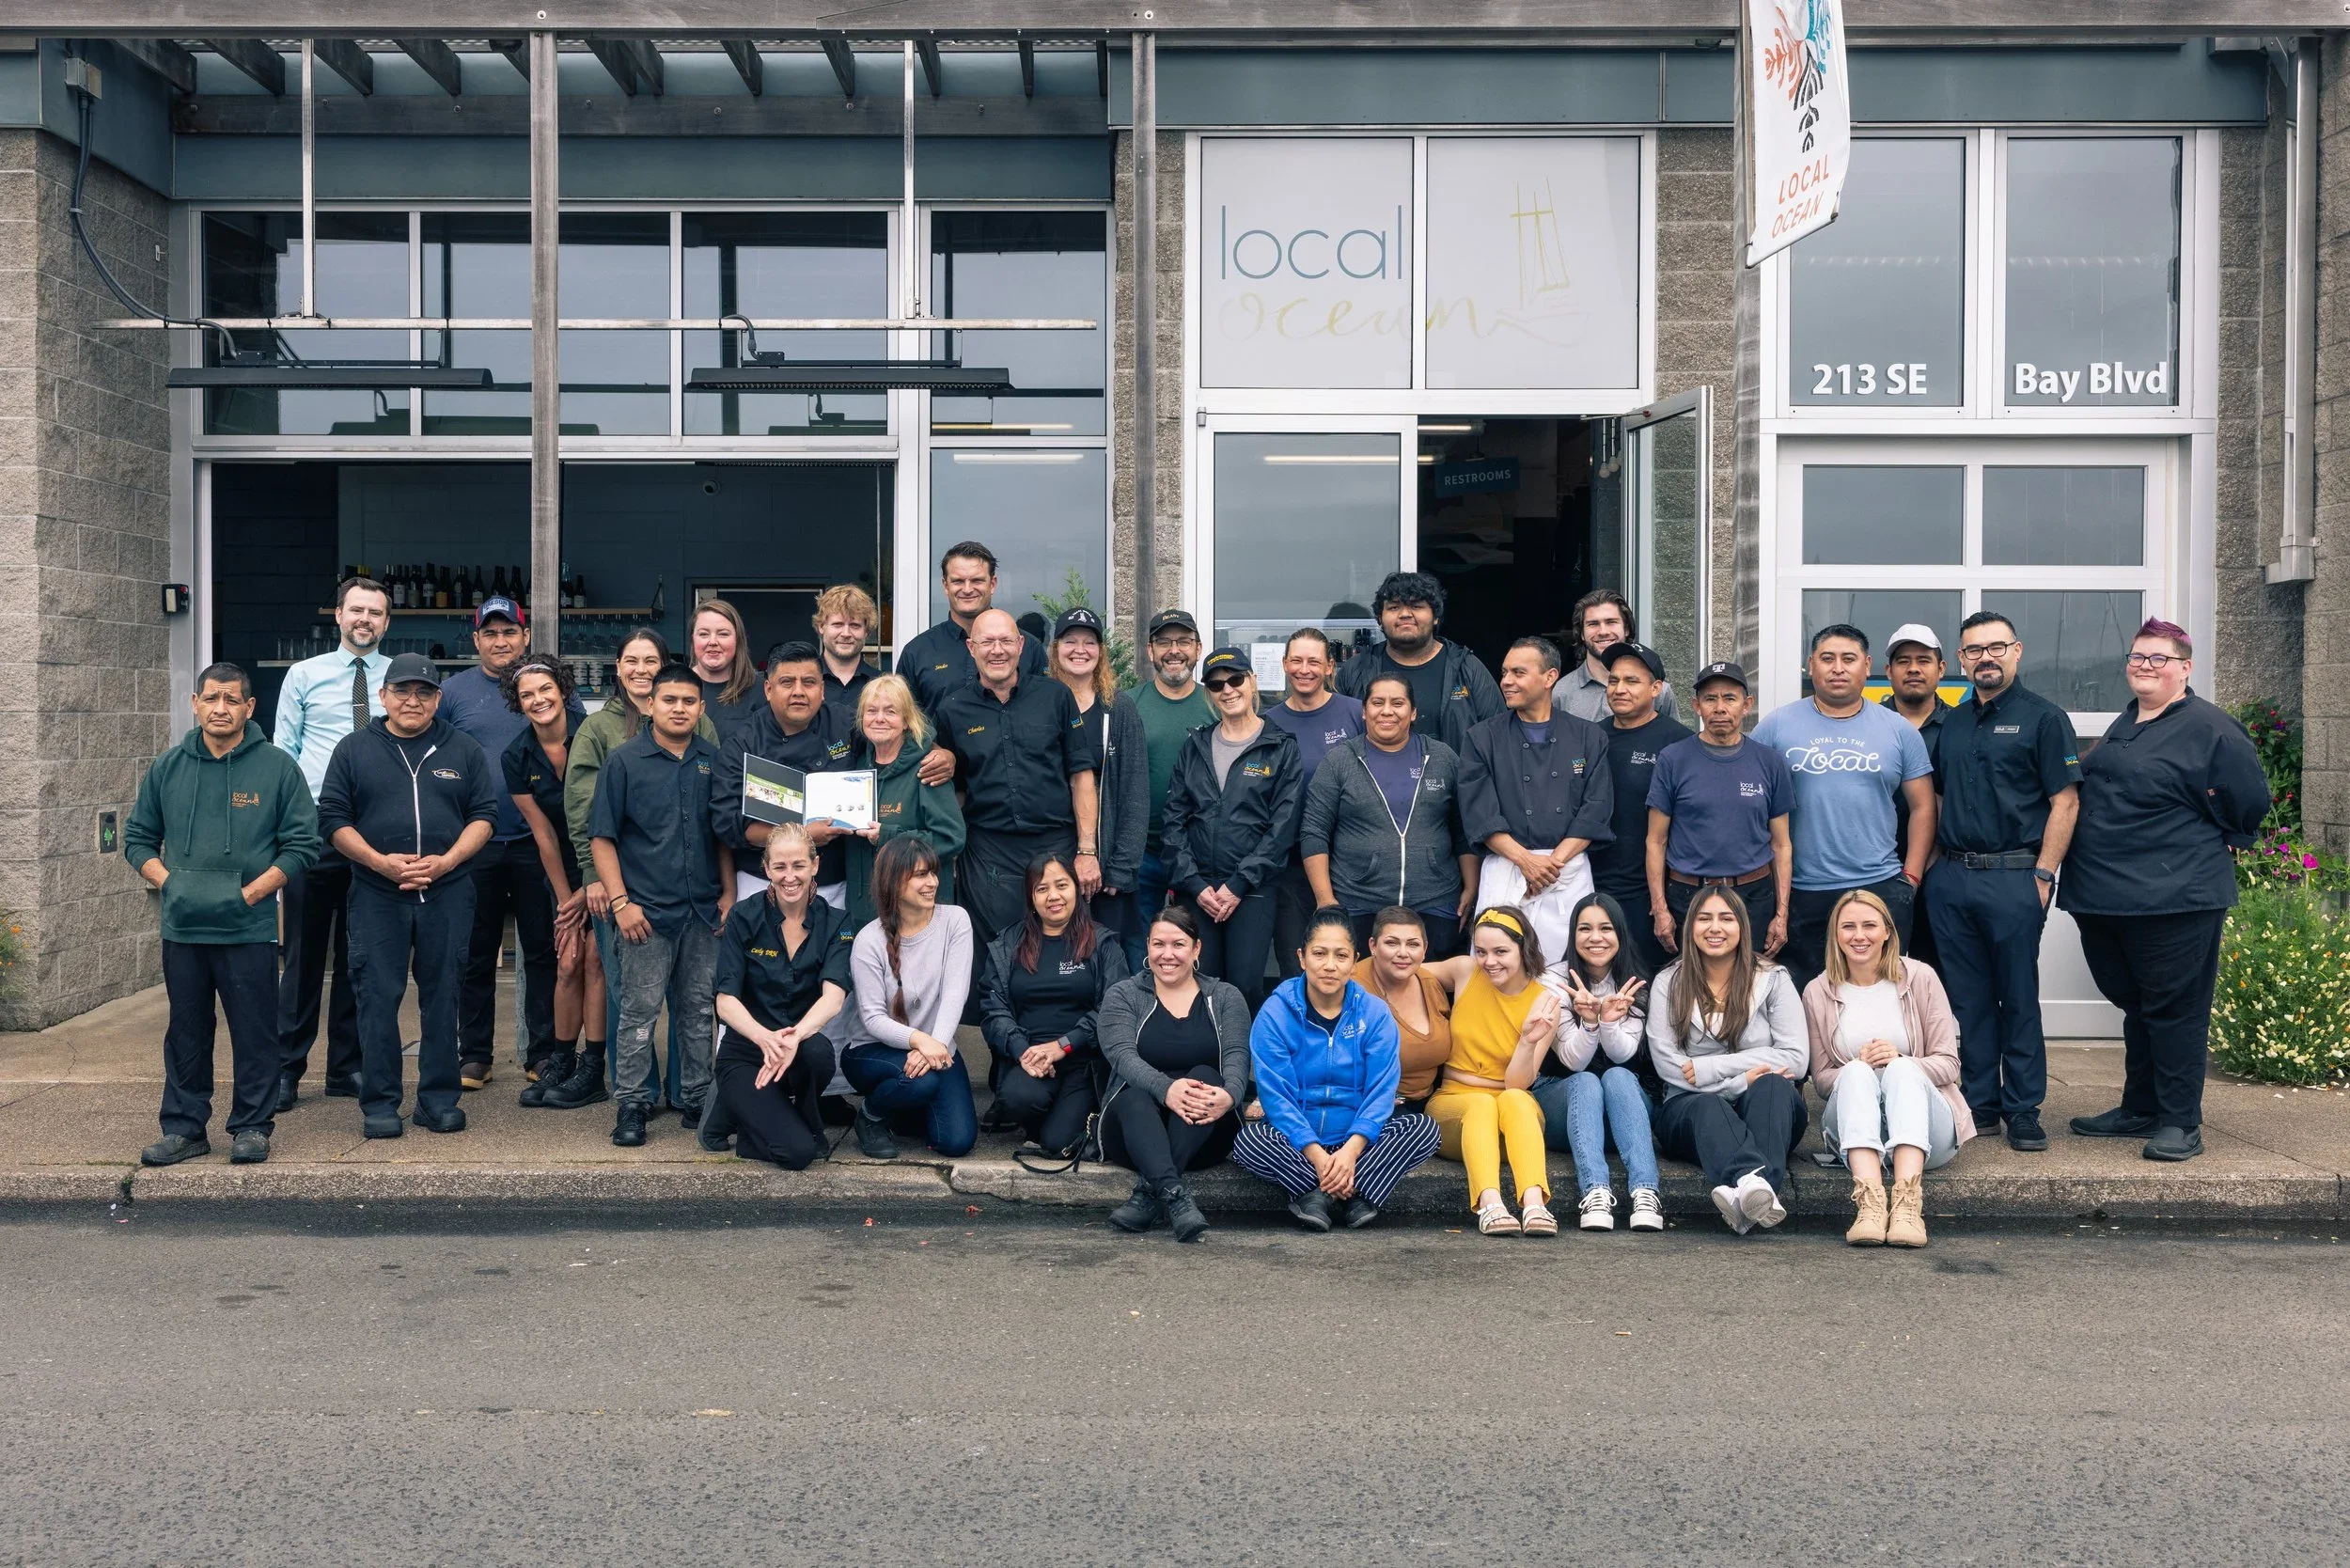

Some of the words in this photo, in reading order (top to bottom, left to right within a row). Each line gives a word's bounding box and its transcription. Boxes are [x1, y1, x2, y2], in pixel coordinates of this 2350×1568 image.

[1778, 154, 1829, 205] LOCAL
[1772, 190, 1824, 239] OCEAN
[1221, 204, 1402, 280] local
[1217, 290, 1496, 342] ocean
[1811, 363, 1876, 395] 213
[1887, 363, 1927, 395] SE
[2015, 363, 2080, 403] Bay
[2090, 362, 2167, 394] Blvd
[1444, 469, 1512, 486] RESTROOMS
[826, 739, 844, 751] local
[1785, 746, 1881, 775] Local
[1810, 737, 1834, 745] LOYAL
[1851, 739, 1866, 747] THE
